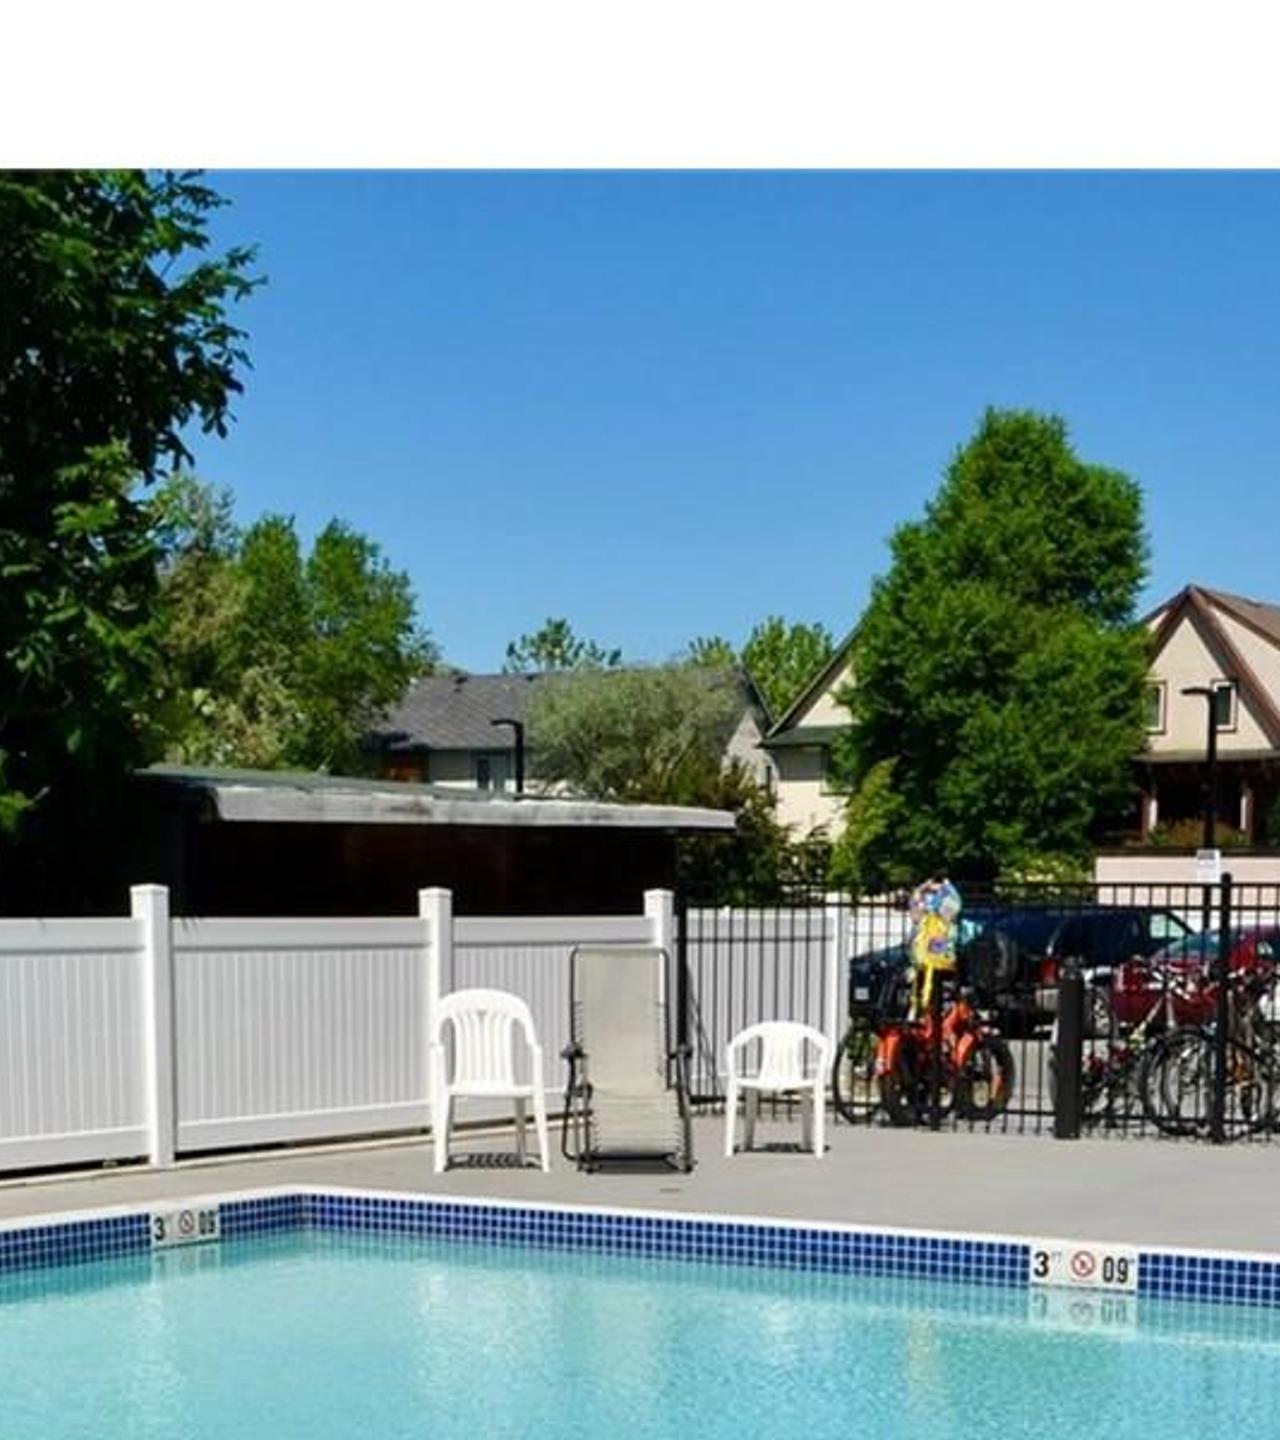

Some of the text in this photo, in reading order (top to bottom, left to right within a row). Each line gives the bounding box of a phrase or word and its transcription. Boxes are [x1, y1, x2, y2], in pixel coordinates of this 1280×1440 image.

[154, 1216, 166, 1241] 3
[1033, 1251, 1129, 1284] 3 09
